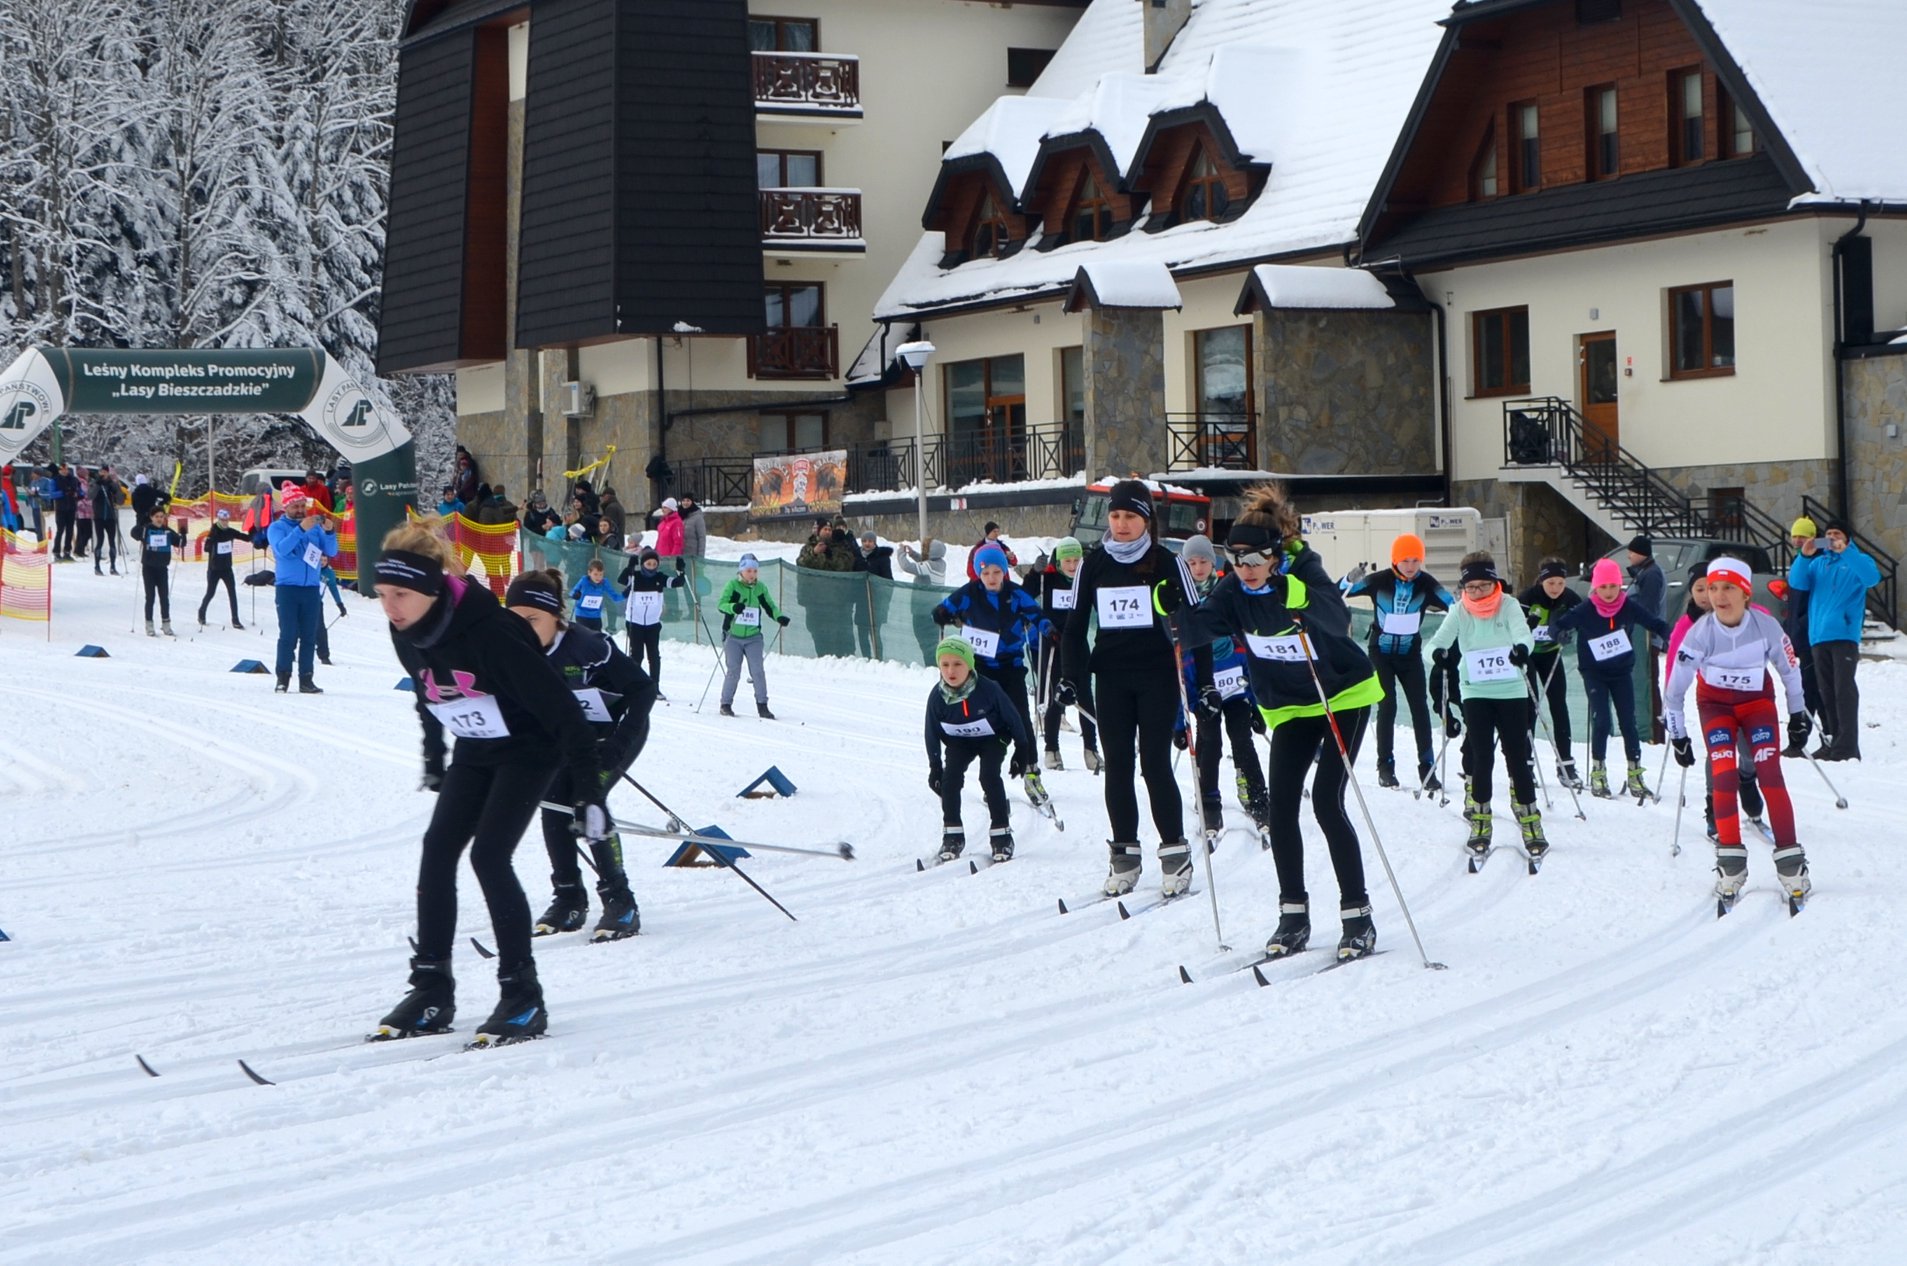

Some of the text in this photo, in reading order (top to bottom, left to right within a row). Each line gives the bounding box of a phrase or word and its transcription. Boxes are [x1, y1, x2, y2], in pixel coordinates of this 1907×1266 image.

[83, 363, 295, 379] Leśny Kompleks Promocyjny
[1110, 598, 1139, 611] 174
[969, 636, 989, 648] 191
[1600, 638, 1620, 650] 188
[1264, 644, 1298, 653] 181
[1478, 656, 1505, 668] 176
[1720, 674, 1751, 684] 175
[452, 711, 485, 728] 173
[955, 726, 981, 734] 190
